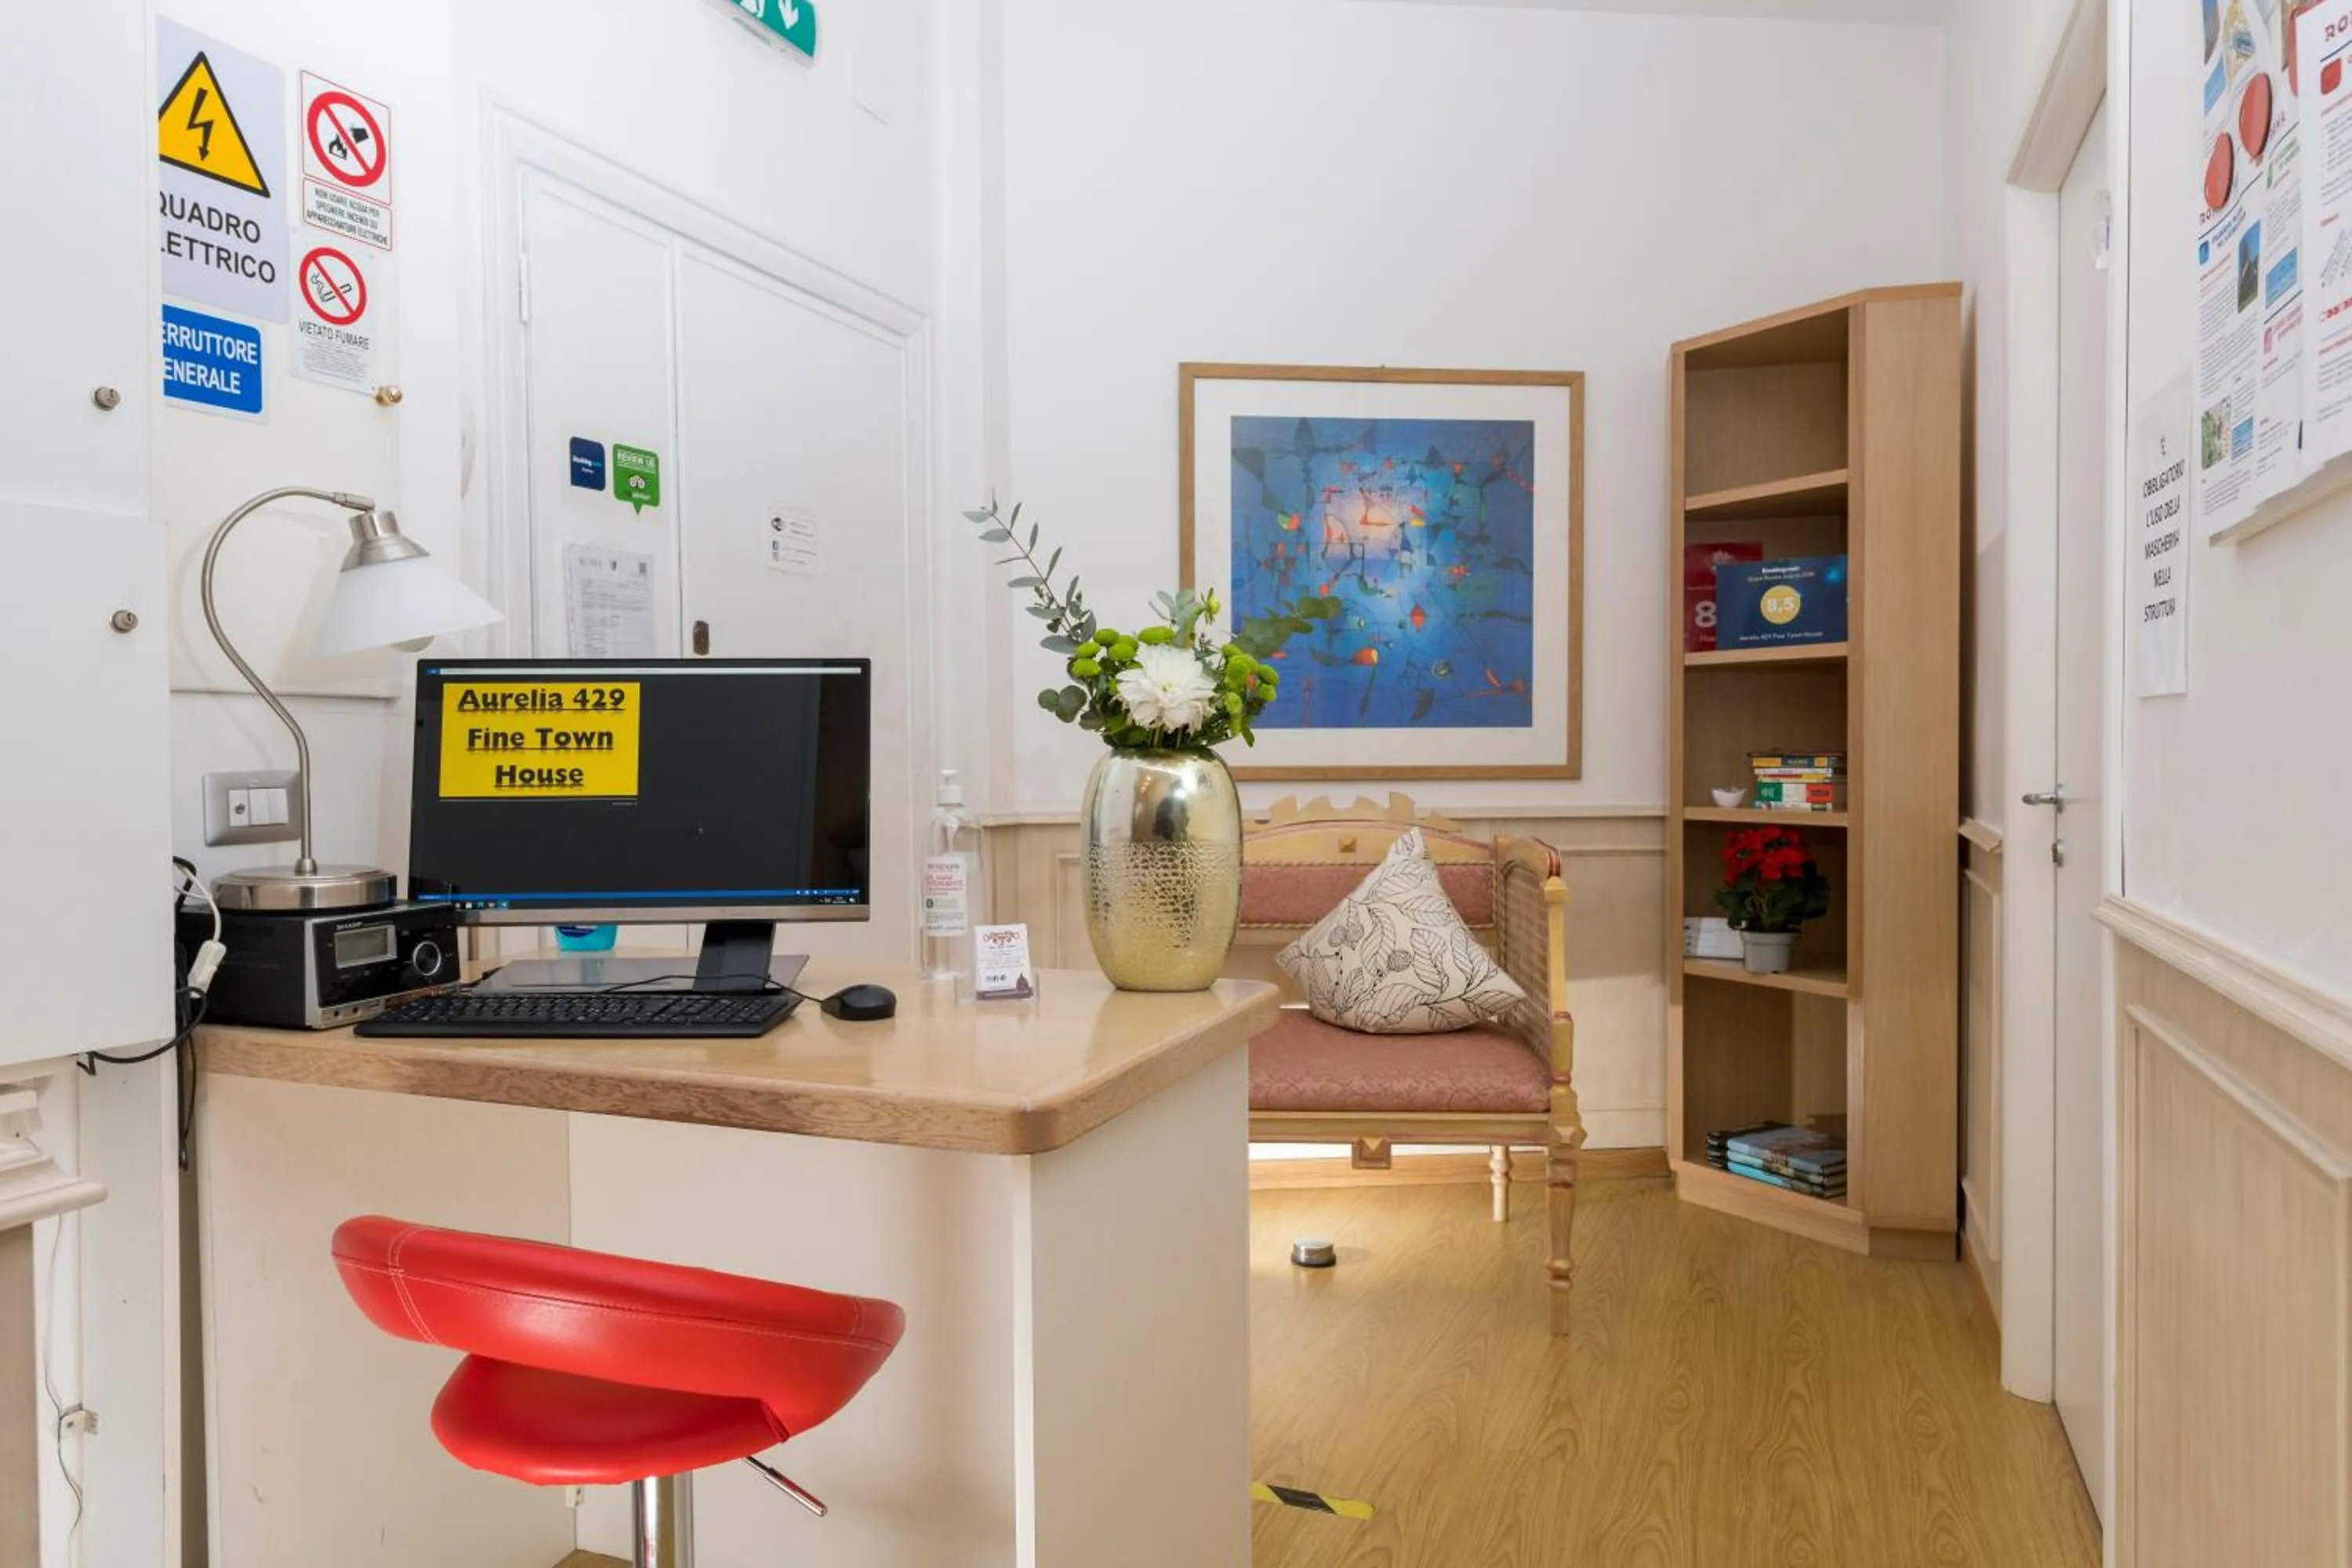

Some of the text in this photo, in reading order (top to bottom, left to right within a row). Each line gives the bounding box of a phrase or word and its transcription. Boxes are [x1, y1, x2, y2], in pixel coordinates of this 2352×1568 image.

[161, 230, 275, 284] ETTRICO
[299, 320, 369, 350] VIETATO FUMARE
[163, 357, 241, 394] ENERALE
[2154, 566, 2171, 588] NELLA
[1767, 597, 1795, 614] 8,5
[458, 688, 626, 709] Aurelia 429
[467, 728, 614, 748] Fine Town
[495, 764, 584, 786] House
